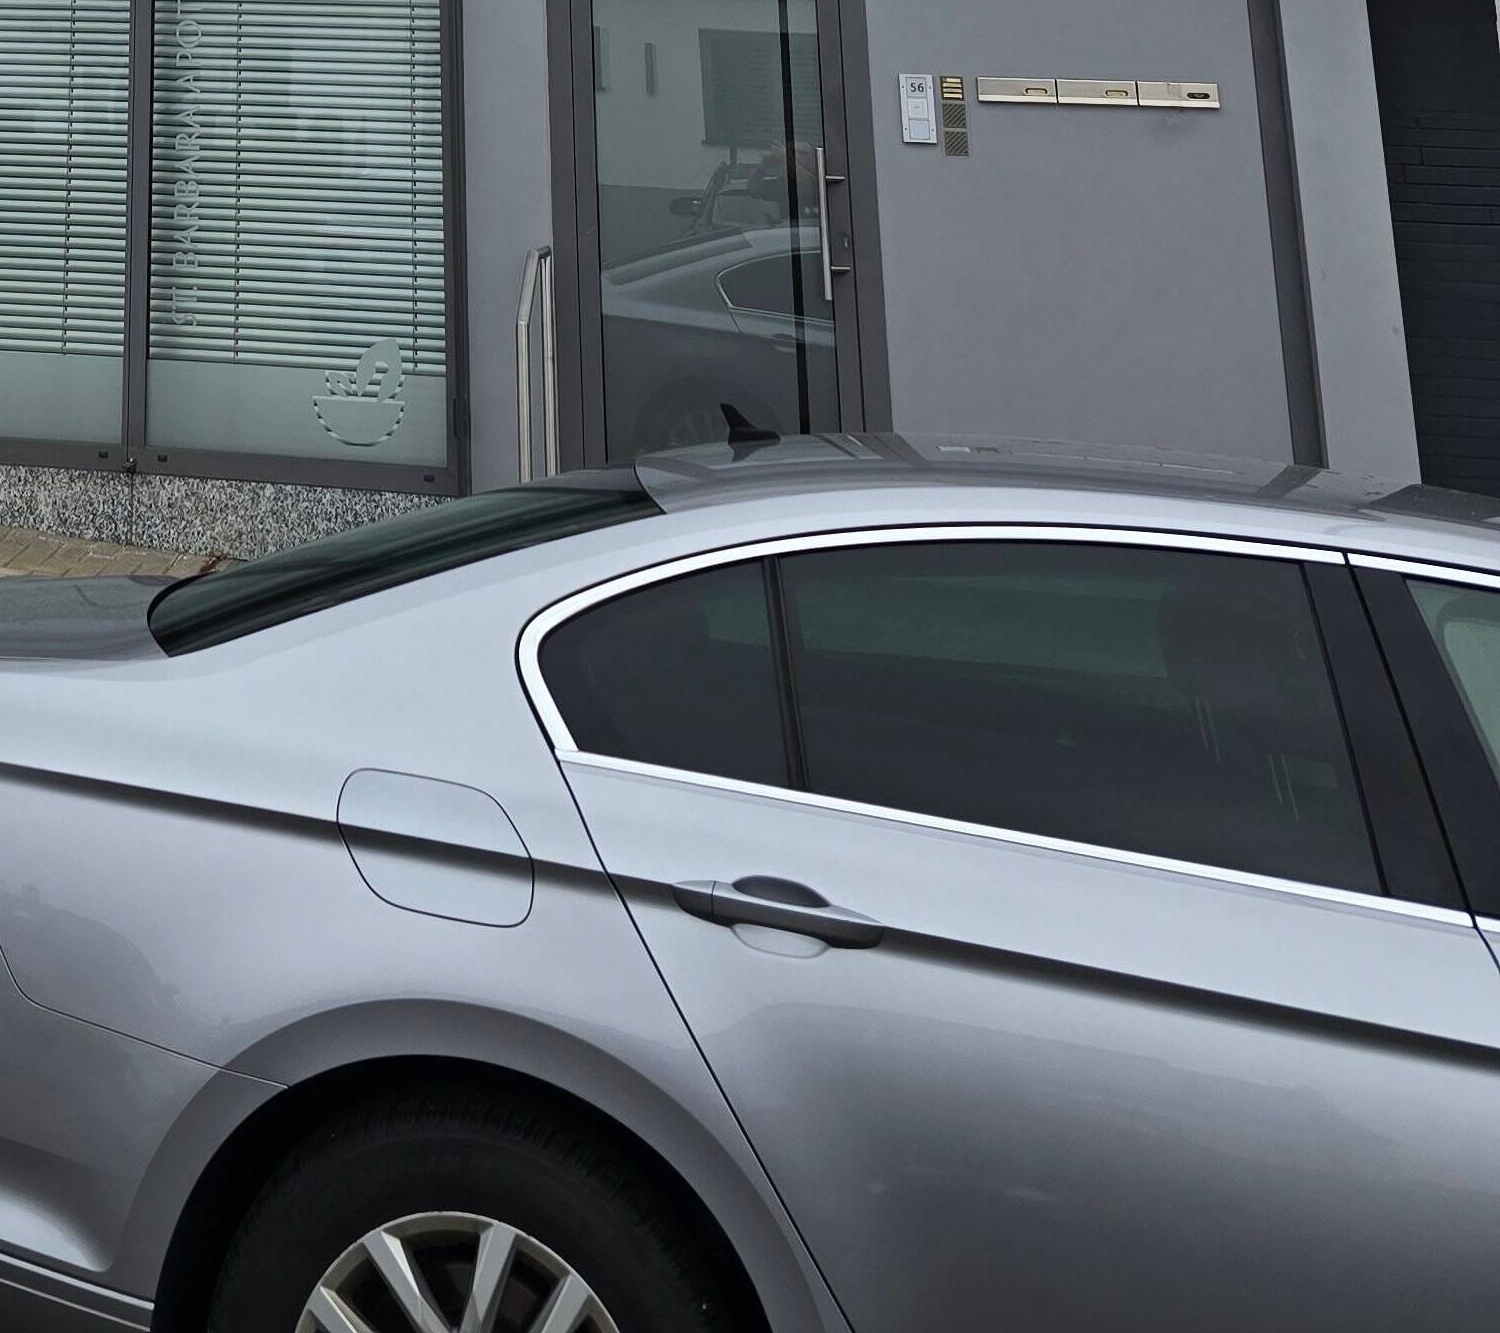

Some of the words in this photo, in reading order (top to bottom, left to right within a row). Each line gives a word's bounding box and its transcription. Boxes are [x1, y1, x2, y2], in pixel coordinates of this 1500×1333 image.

[910, 82, 925, 93] 56
[172, 106, 200, 269] BARBARA
[171, 286, 199, 326] ST.
